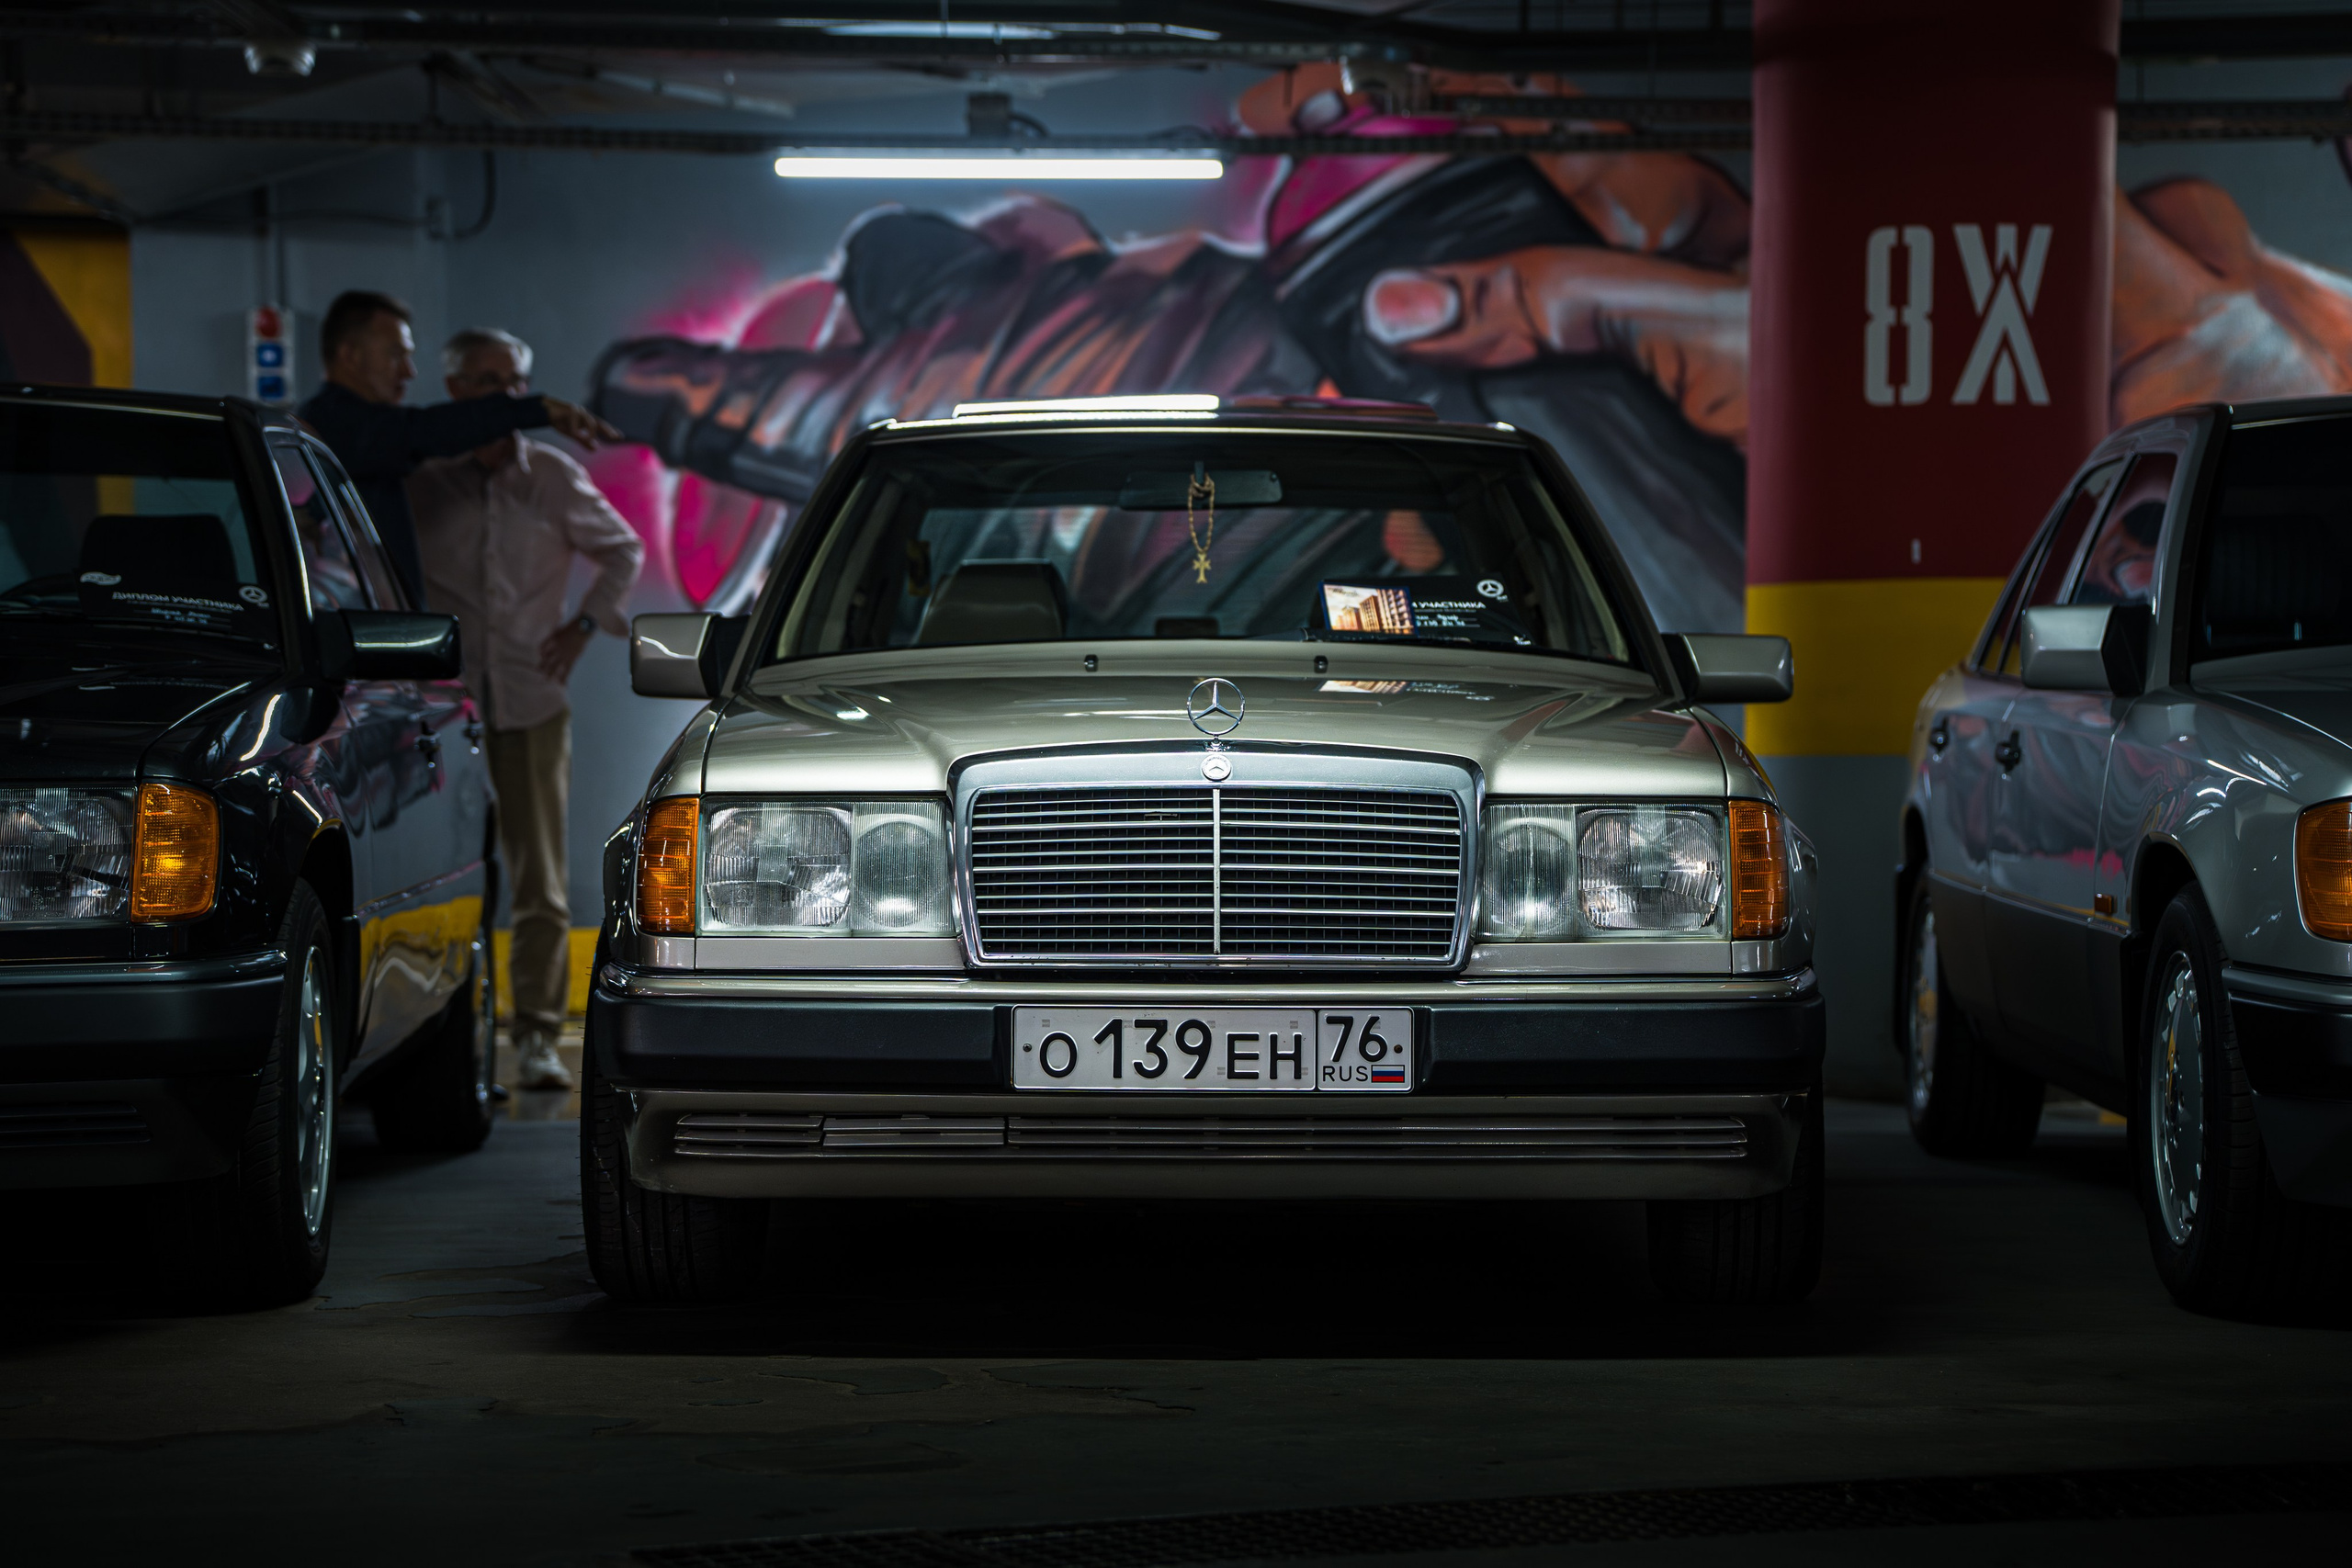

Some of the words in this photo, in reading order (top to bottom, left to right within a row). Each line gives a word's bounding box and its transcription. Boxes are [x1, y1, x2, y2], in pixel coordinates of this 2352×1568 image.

[171, 594, 244, 611] УЧАСТНИКА
[1419, 601, 1487, 609] УЧАСТНИКА
[1325, 1015, 1388, 1063] 76
[1322, 1065, 1369, 1083] RUS
